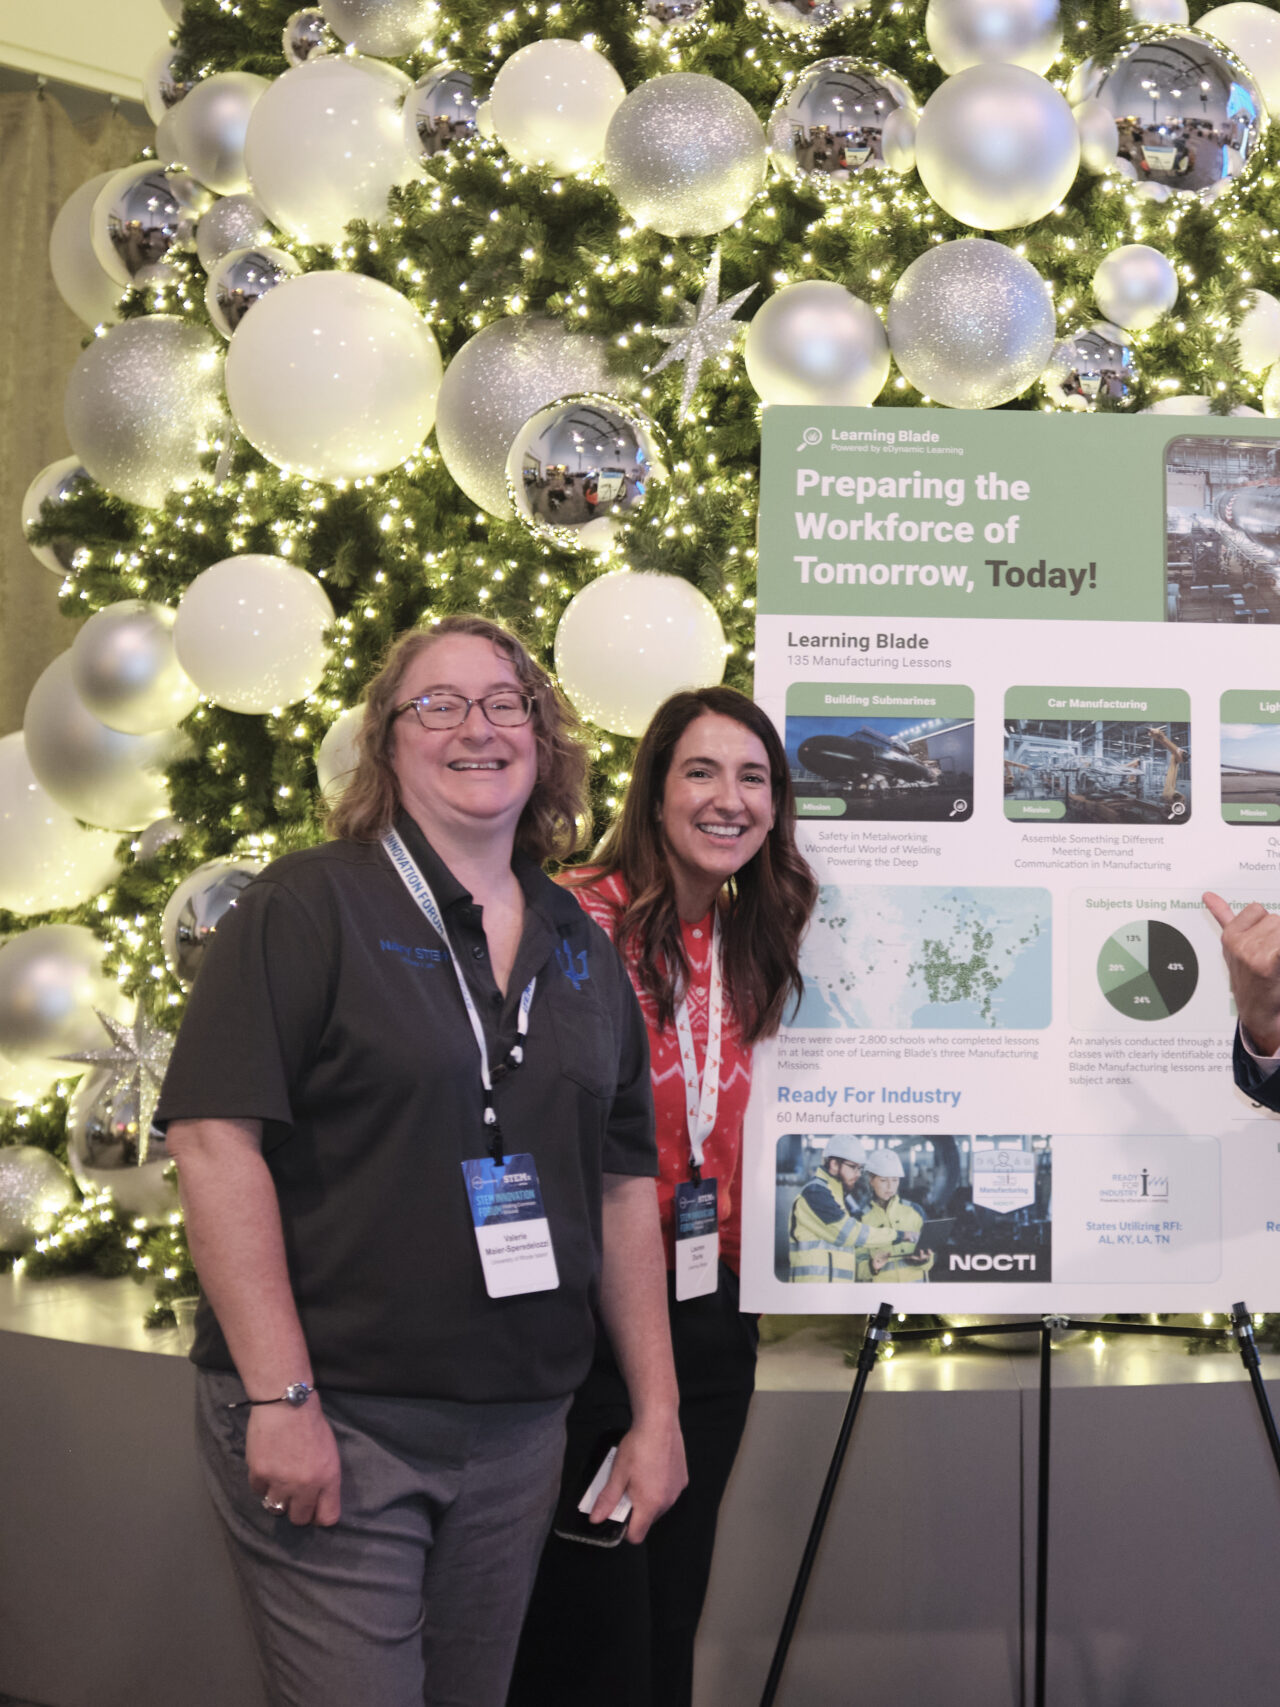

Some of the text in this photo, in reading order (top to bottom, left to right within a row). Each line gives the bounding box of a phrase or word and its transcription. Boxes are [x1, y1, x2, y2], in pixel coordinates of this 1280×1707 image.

[832, 429, 940, 443] Learning Blade
[831, 444, 964, 456] Powered by eDynamic Learning
[796, 468, 1030, 507] Preparing the
[795, 512, 1020, 544] Workforce of
[793, 556, 1097, 596] Tomorrow, Today!
[788, 632, 929, 652] Learning Blade
[787, 655, 952, 669] 135 Manufacturing Lessons
[824, 694, 936, 707] Building Submarines
[1048, 698, 1148, 711] Car Manufacturing
[819, 831, 928, 843] Safety in Metalworking
[1022, 834, 1164, 845] Assemble Something Different
[805, 844, 941, 856] Wonderful World of Welding
[1052, 847, 1133, 858] Meeting Demand
[827, 857, 918, 868] Powering the Deep
[1014, 859, 1171, 871] Communication in Manufacturing
[1239, 862, 1276, 871] Modern
[1086, 899, 1132, 911] Subjects
[1136, 899, 1167, 910] Using
[778, 1035, 805, 1045] There
[808, 1037, 833, 1045] were
[835, 1037, 856, 1045] over
[889, 1036, 926, 1045] schools
[928, 1036, 949, 1045] who
[951, 1036, 1002, 1048] completed
[1005, 1037, 1039, 1046] lessons
[1069, 1037, 1082, 1046] An
[1085, 1037, 1122, 1048] analysis
[1125, 1037, 1175, 1047] conducted
[1178, 1037, 1215, 1049] through
[778, 1048, 787, 1057] in
[789, 1049, 799, 1057] at
[802, 1048, 824, 1057] least
[827, 1050, 845, 1058] one
[848, 1048, 858, 1058] of
[860, 1049, 901, 1060] Learning
[940, 1049, 965, 1058] three
[968, 1049, 1039, 1060] Manufacturing
[1069, 1050, 1102, 1059] classes
[1104, 1050, 1125, 1059] with
[1128, 1050, 1159, 1061] clearly
[1161, 1050, 1214, 1060] identifiable
[778, 1061, 821, 1071] Missions.
[1069, 1062, 1096, 1072] Blade
[1099, 1063, 1168, 1074] Manufacturing
[1170, 1063, 1205, 1072] lessons
[1069, 1076, 1132, 1086] subject areas.
[777, 1086, 962, 1108] Ready For Industry
[777, 1111, 940, 1126] 60 Manufacturing Lessons
[1086, 1221, 1116, 1231] States
[1119, 1221, 1160, 1232] Utilizing
[1154, 1235, 1170, 1244] TN
[949, 1254, 1036, 1271] NOCTI
